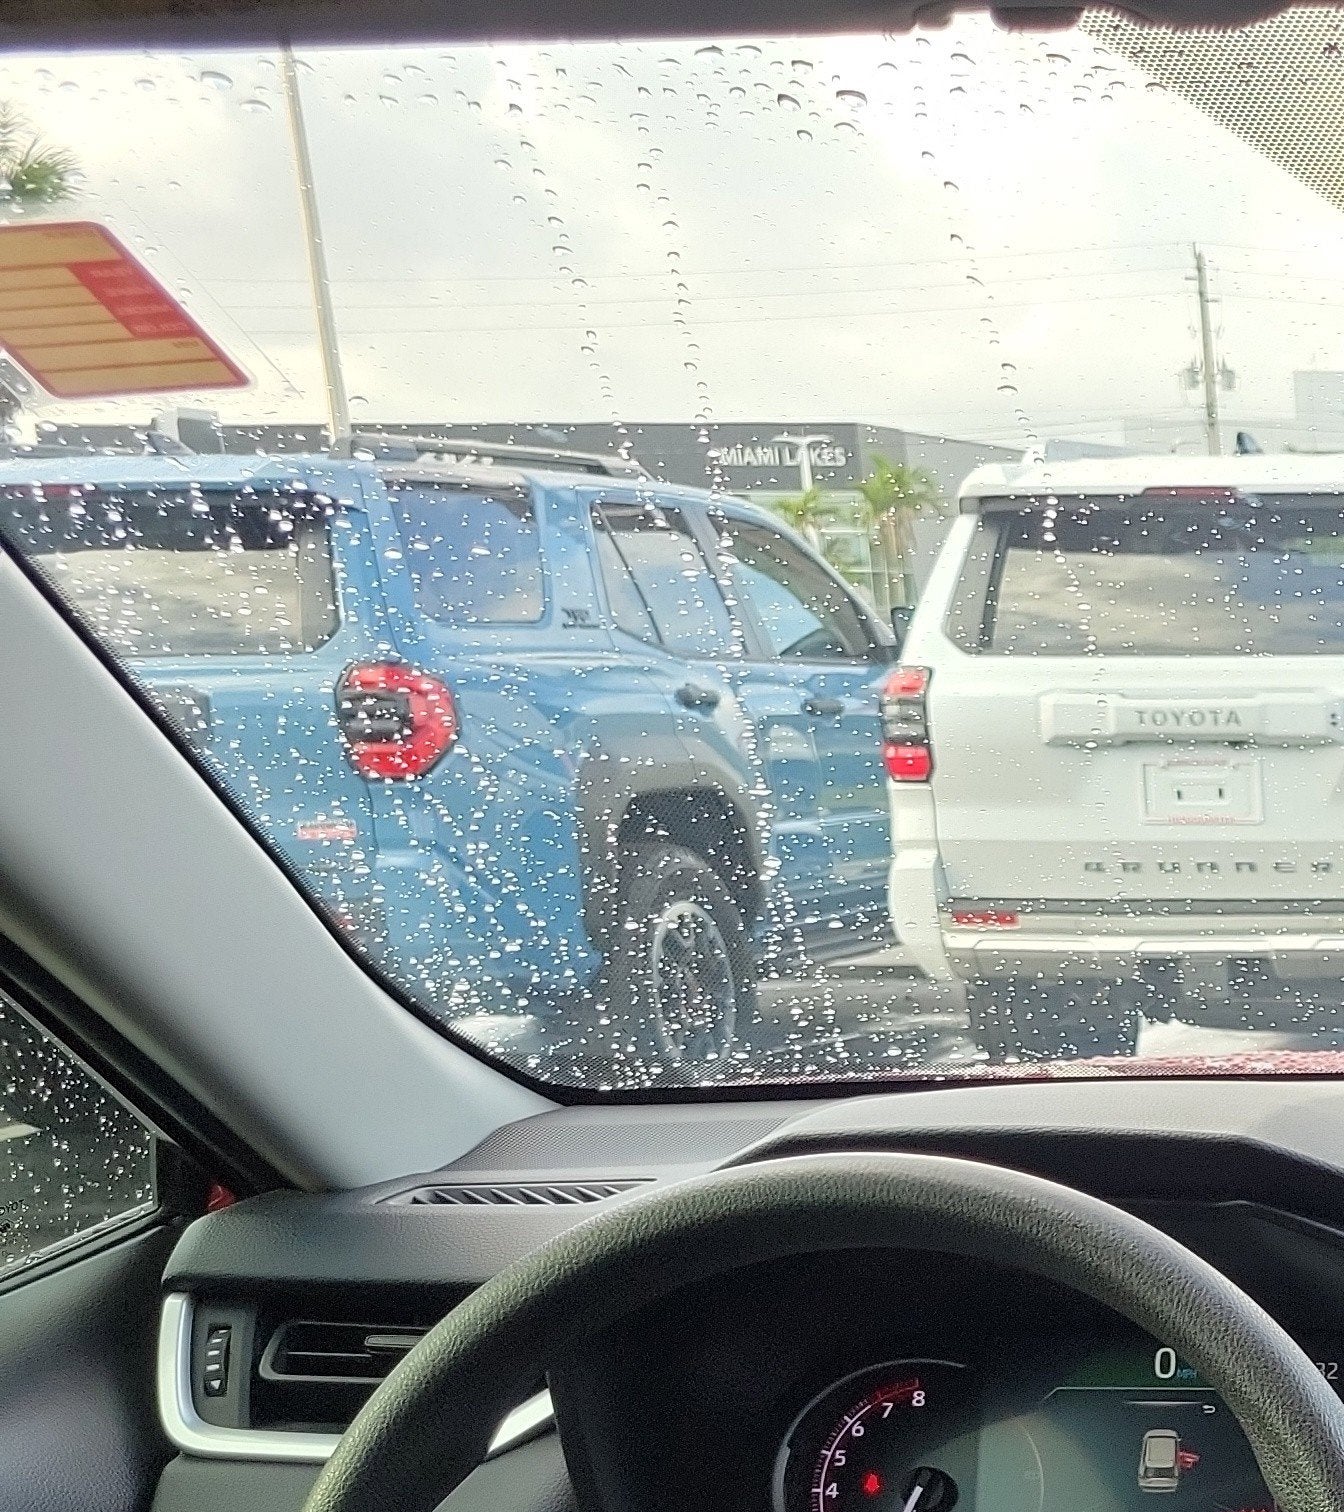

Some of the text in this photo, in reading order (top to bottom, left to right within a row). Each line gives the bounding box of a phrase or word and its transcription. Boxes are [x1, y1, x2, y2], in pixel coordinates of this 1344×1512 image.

[721, 446, 780, 467] MIAMI
[1135, 710, 1241, 726] TOYOTA
[1154, 1347, 1176, 1378] 0
[912, 1391, 925, 1406] 8
[882, 1403, 893, 1418] 7
[852, 1421, 864, 1436] 6
[834, 1451, 846, 1466] 5
[826, 1483, 839, 1498] 4
